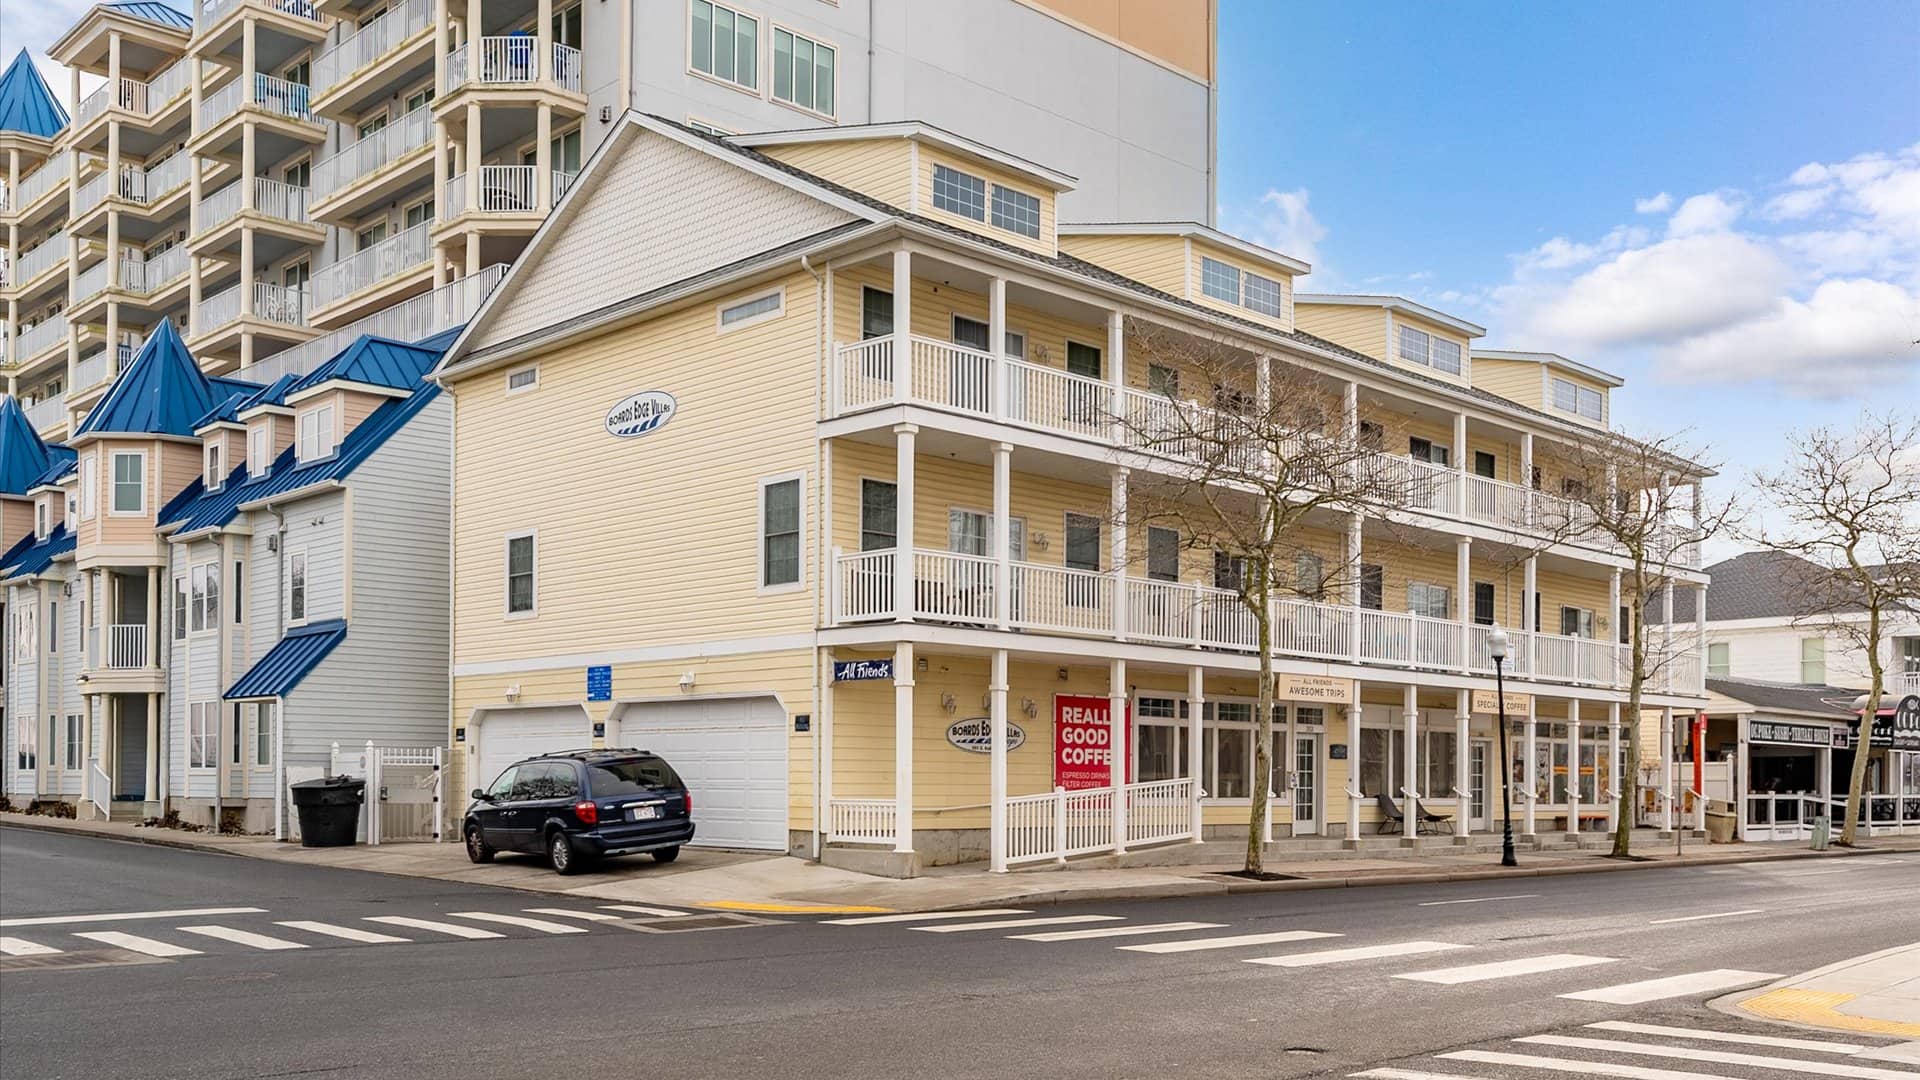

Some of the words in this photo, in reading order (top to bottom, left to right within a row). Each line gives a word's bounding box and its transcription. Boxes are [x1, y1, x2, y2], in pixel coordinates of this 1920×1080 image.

[634, 400, 650, 420] EDGE
[838, 662, 857, 680] All
[857, 662, 889, 678] Friends
[1289, 686, 1324, 697] AWESOME
[1325, 688, 1345, 698] TRIPS
[1506, 702, 1527, 711] COFFEE
[1062, 706, 1111, 726] REALL
[952, 723, 980, 737] BOARDS
[982, 720, 992, 736] ED
[1062, 727, 1108, 745] GOOD
[1062, 747, 1111, 766] COFFE
[1062, 771, 1090, 779] ESPRESSO
[1062, 780, 1080, 788] FILTER
